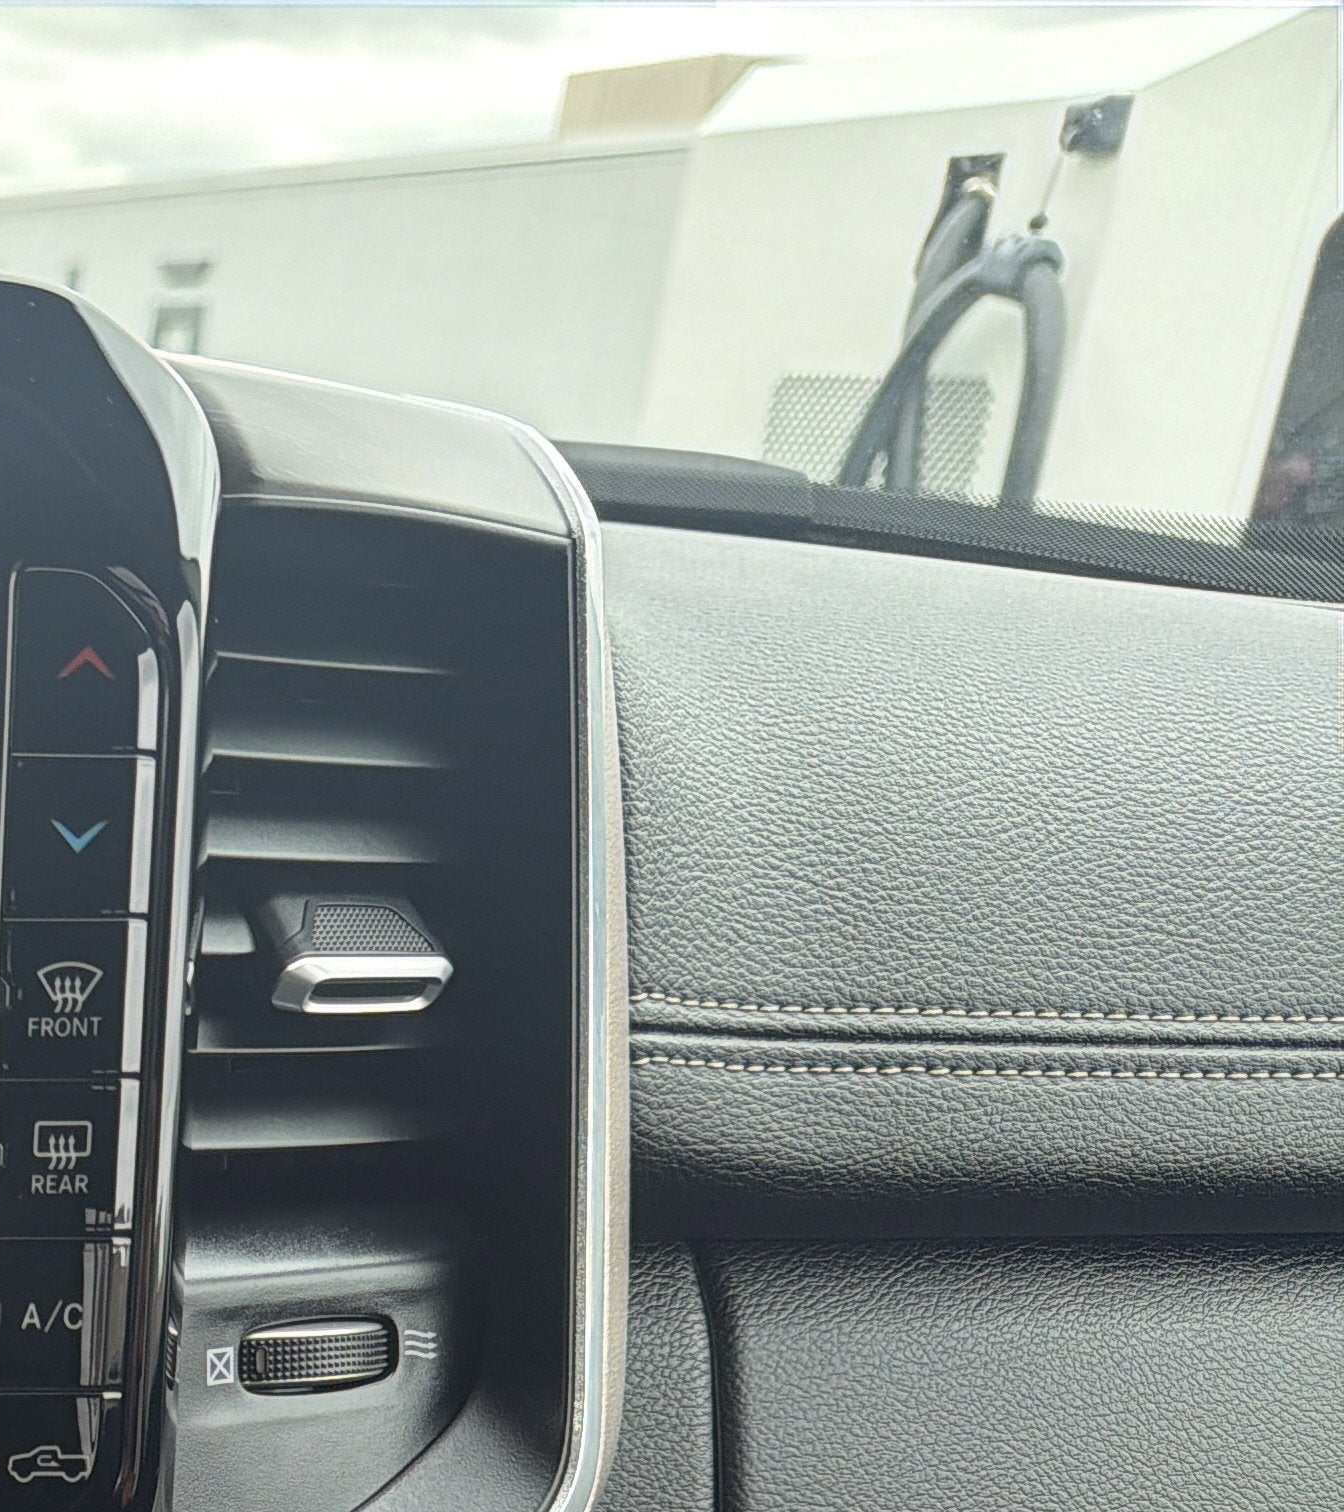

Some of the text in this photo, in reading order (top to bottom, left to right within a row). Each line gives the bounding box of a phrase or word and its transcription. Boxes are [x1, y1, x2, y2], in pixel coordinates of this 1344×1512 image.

[27, 1016, 102, 1038] FRONT
[31, 1174, 89, 1195] REAR
[20, 1300, 85, 1333] A/C
